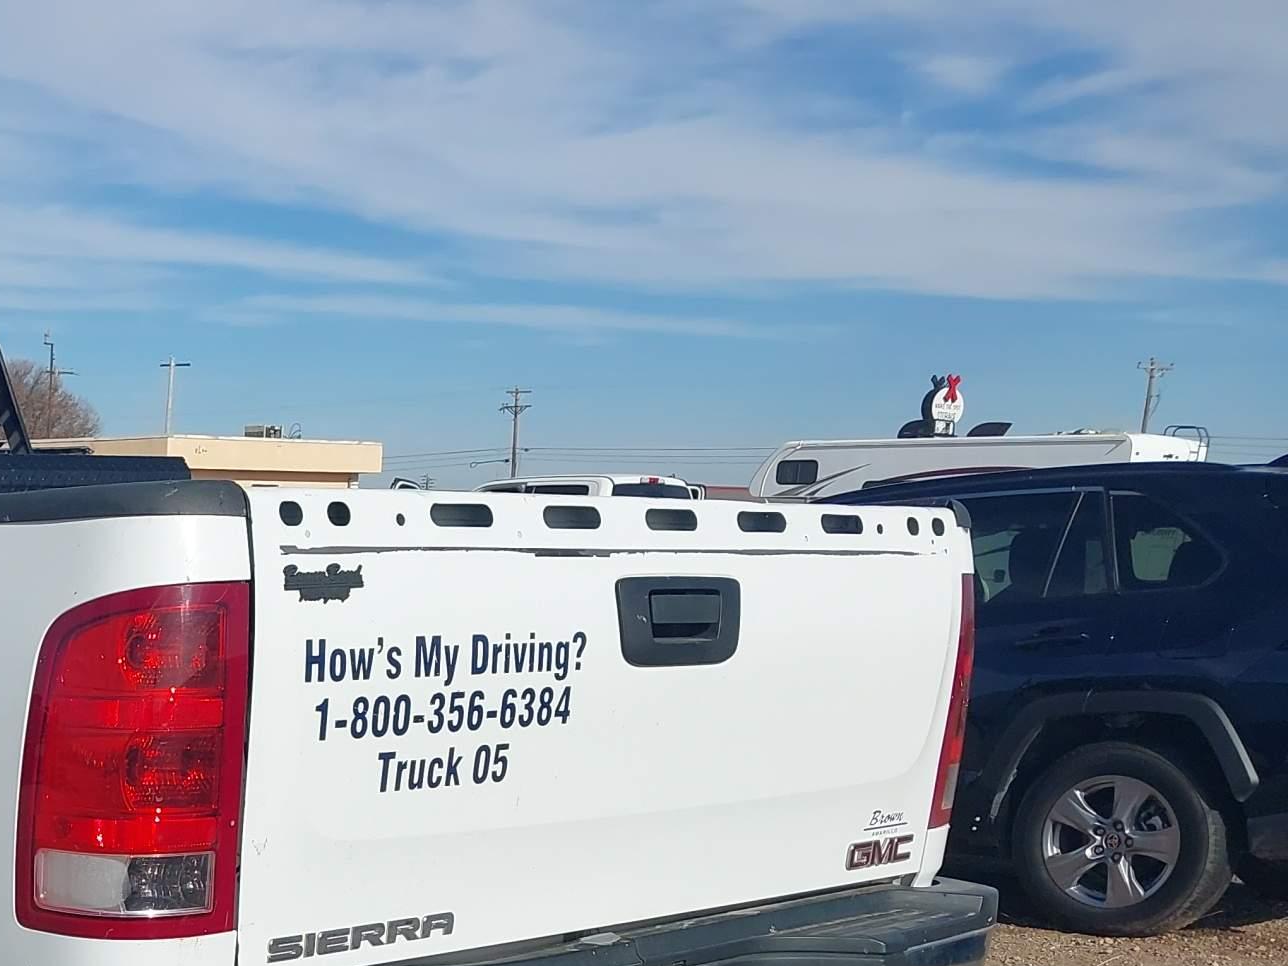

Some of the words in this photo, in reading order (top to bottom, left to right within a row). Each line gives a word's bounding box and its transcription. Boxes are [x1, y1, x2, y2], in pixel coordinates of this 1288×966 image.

[304, 637, 402, 683] How's
[414, 635, 459, 686] My
[470, 632, 587, 681] Driving?
[315, 686, 571, 741] 1-800-356-6384
[378, 747, 462, 793] Truck
[472, 743, 510, 784] 05
[869, 809, 904, 826] Brown
[845, 834, 914, 871] GMC
[267, 911, 455, 963] SIERRA
